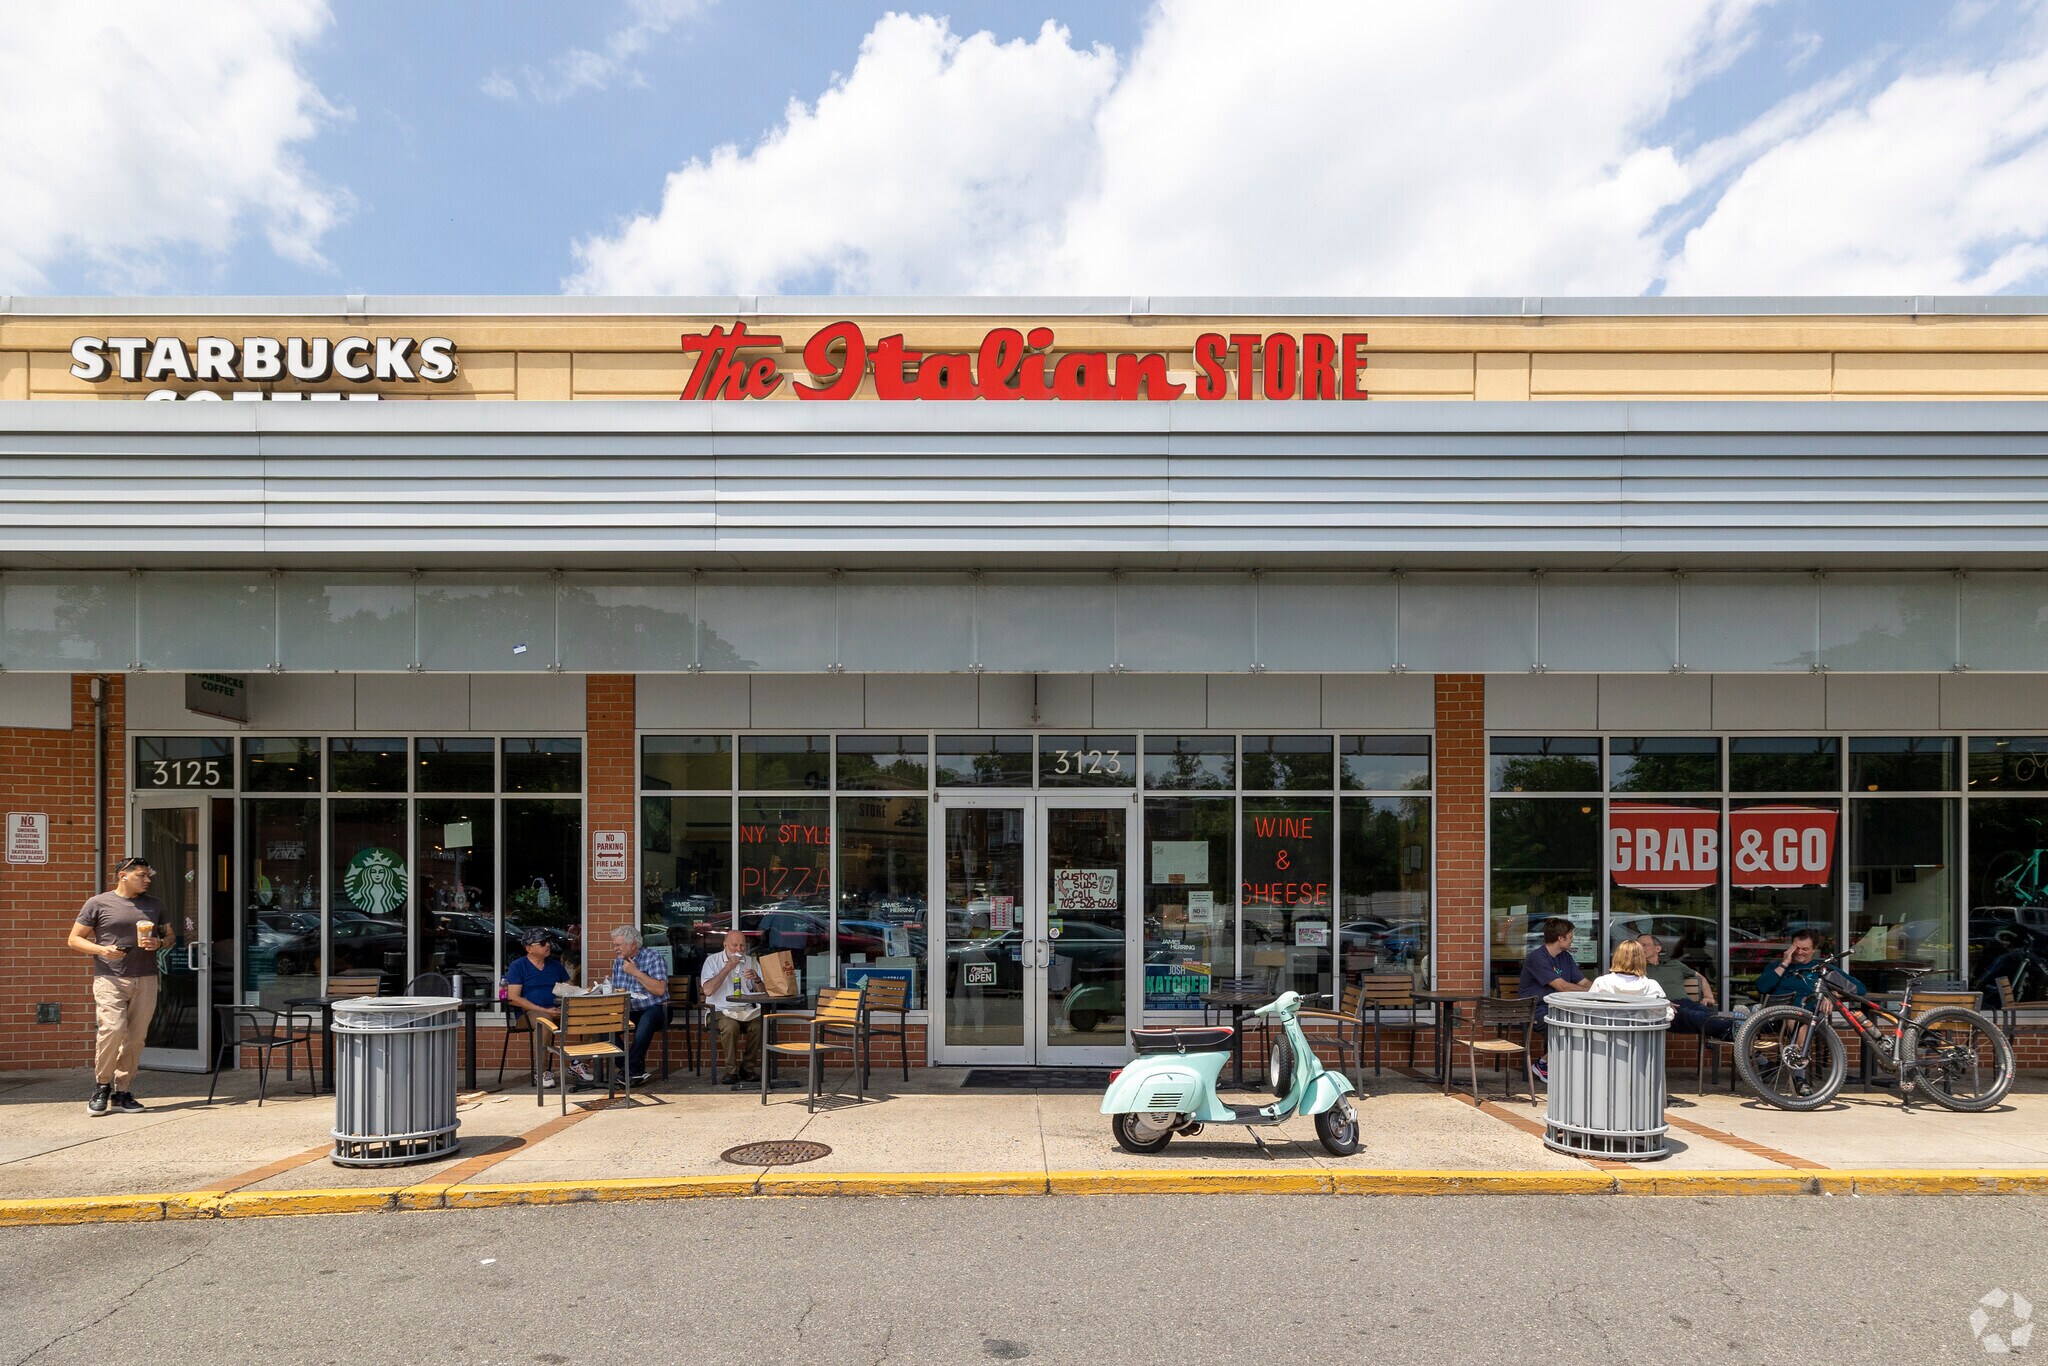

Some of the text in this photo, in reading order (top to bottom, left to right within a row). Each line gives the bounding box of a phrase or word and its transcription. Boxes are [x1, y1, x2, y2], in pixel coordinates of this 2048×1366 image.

[69, 336, 458, 382] STARBUCKS
[679, 320, 1368, 400] The Italian STORE
[201, 681, 235, 697] COFFEE
[1054, 749, 1121, 774] 3123
[152, 760, 221, 786] 3125
[859, 802, 887, 818] STORE
[20, 816, 35, 826] NO
[1255, 816, 1313, 839] WINE
[605, 834, 615, 842] NO
[740, 824, 766, 844] NY
[1609, 827, 1718, 871] GRAB
[1276, 849, 1290, 870] &
[1061, 870, 1098, 880] Custom
[1073, 880, 1098, 889] Subs
[1240, 882, 1328, 905] CHEESE
[1059, 897, 1117, 909] 703-528-6266
[968, 973, 992, 983] OPEN
[1168, 965, 1186, 975] JOSH
[1145, 975, 1209, 993] KATCHER
